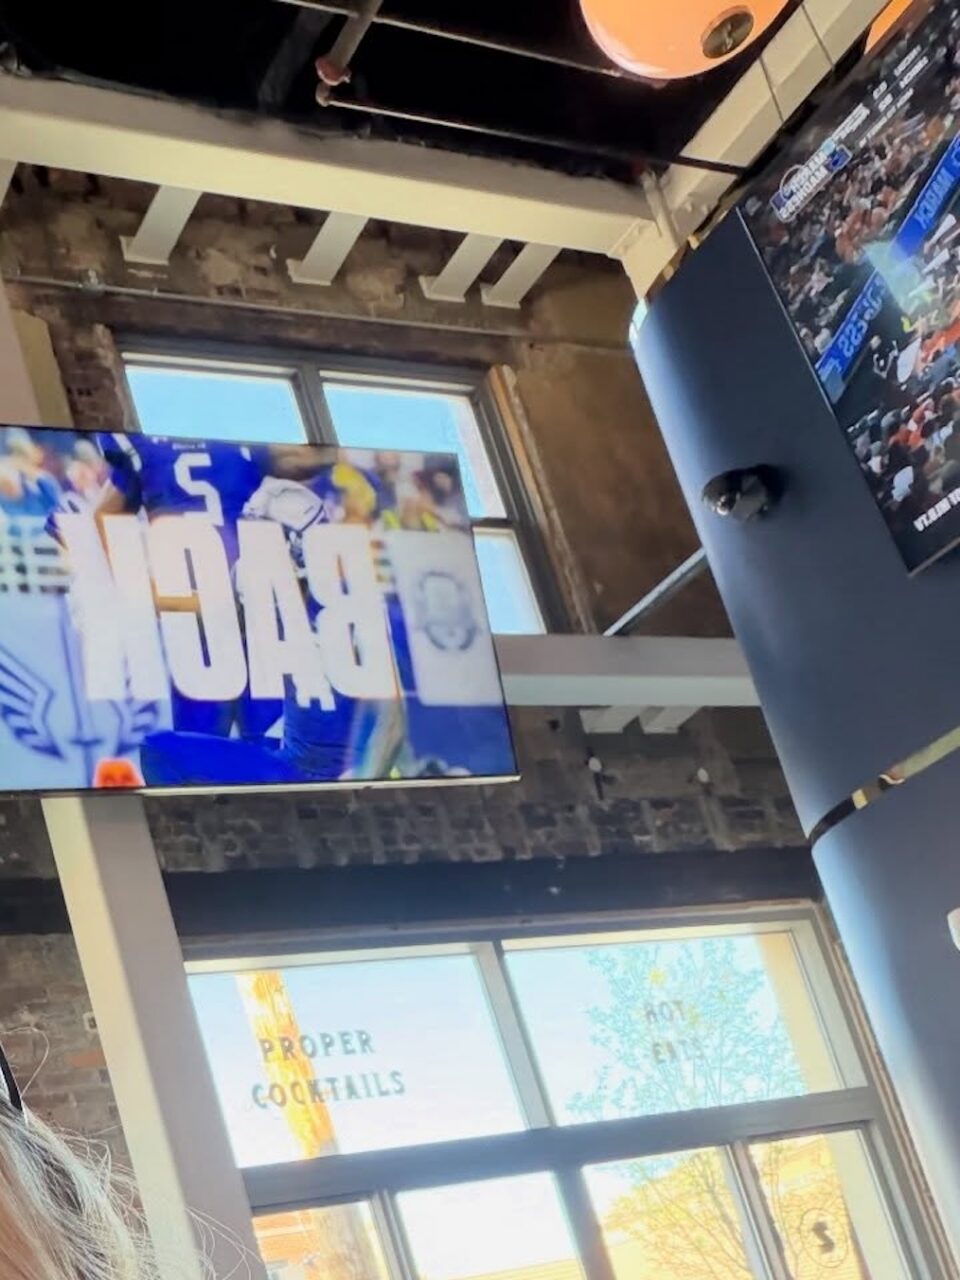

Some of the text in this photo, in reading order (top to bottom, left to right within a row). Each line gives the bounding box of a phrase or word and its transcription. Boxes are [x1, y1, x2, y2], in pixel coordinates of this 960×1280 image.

[643, 999, 686, 1022] HOT
[257, 1029, 376, 1063] PROPER
[250, 1070, 407, 1110] COCKTAILS
